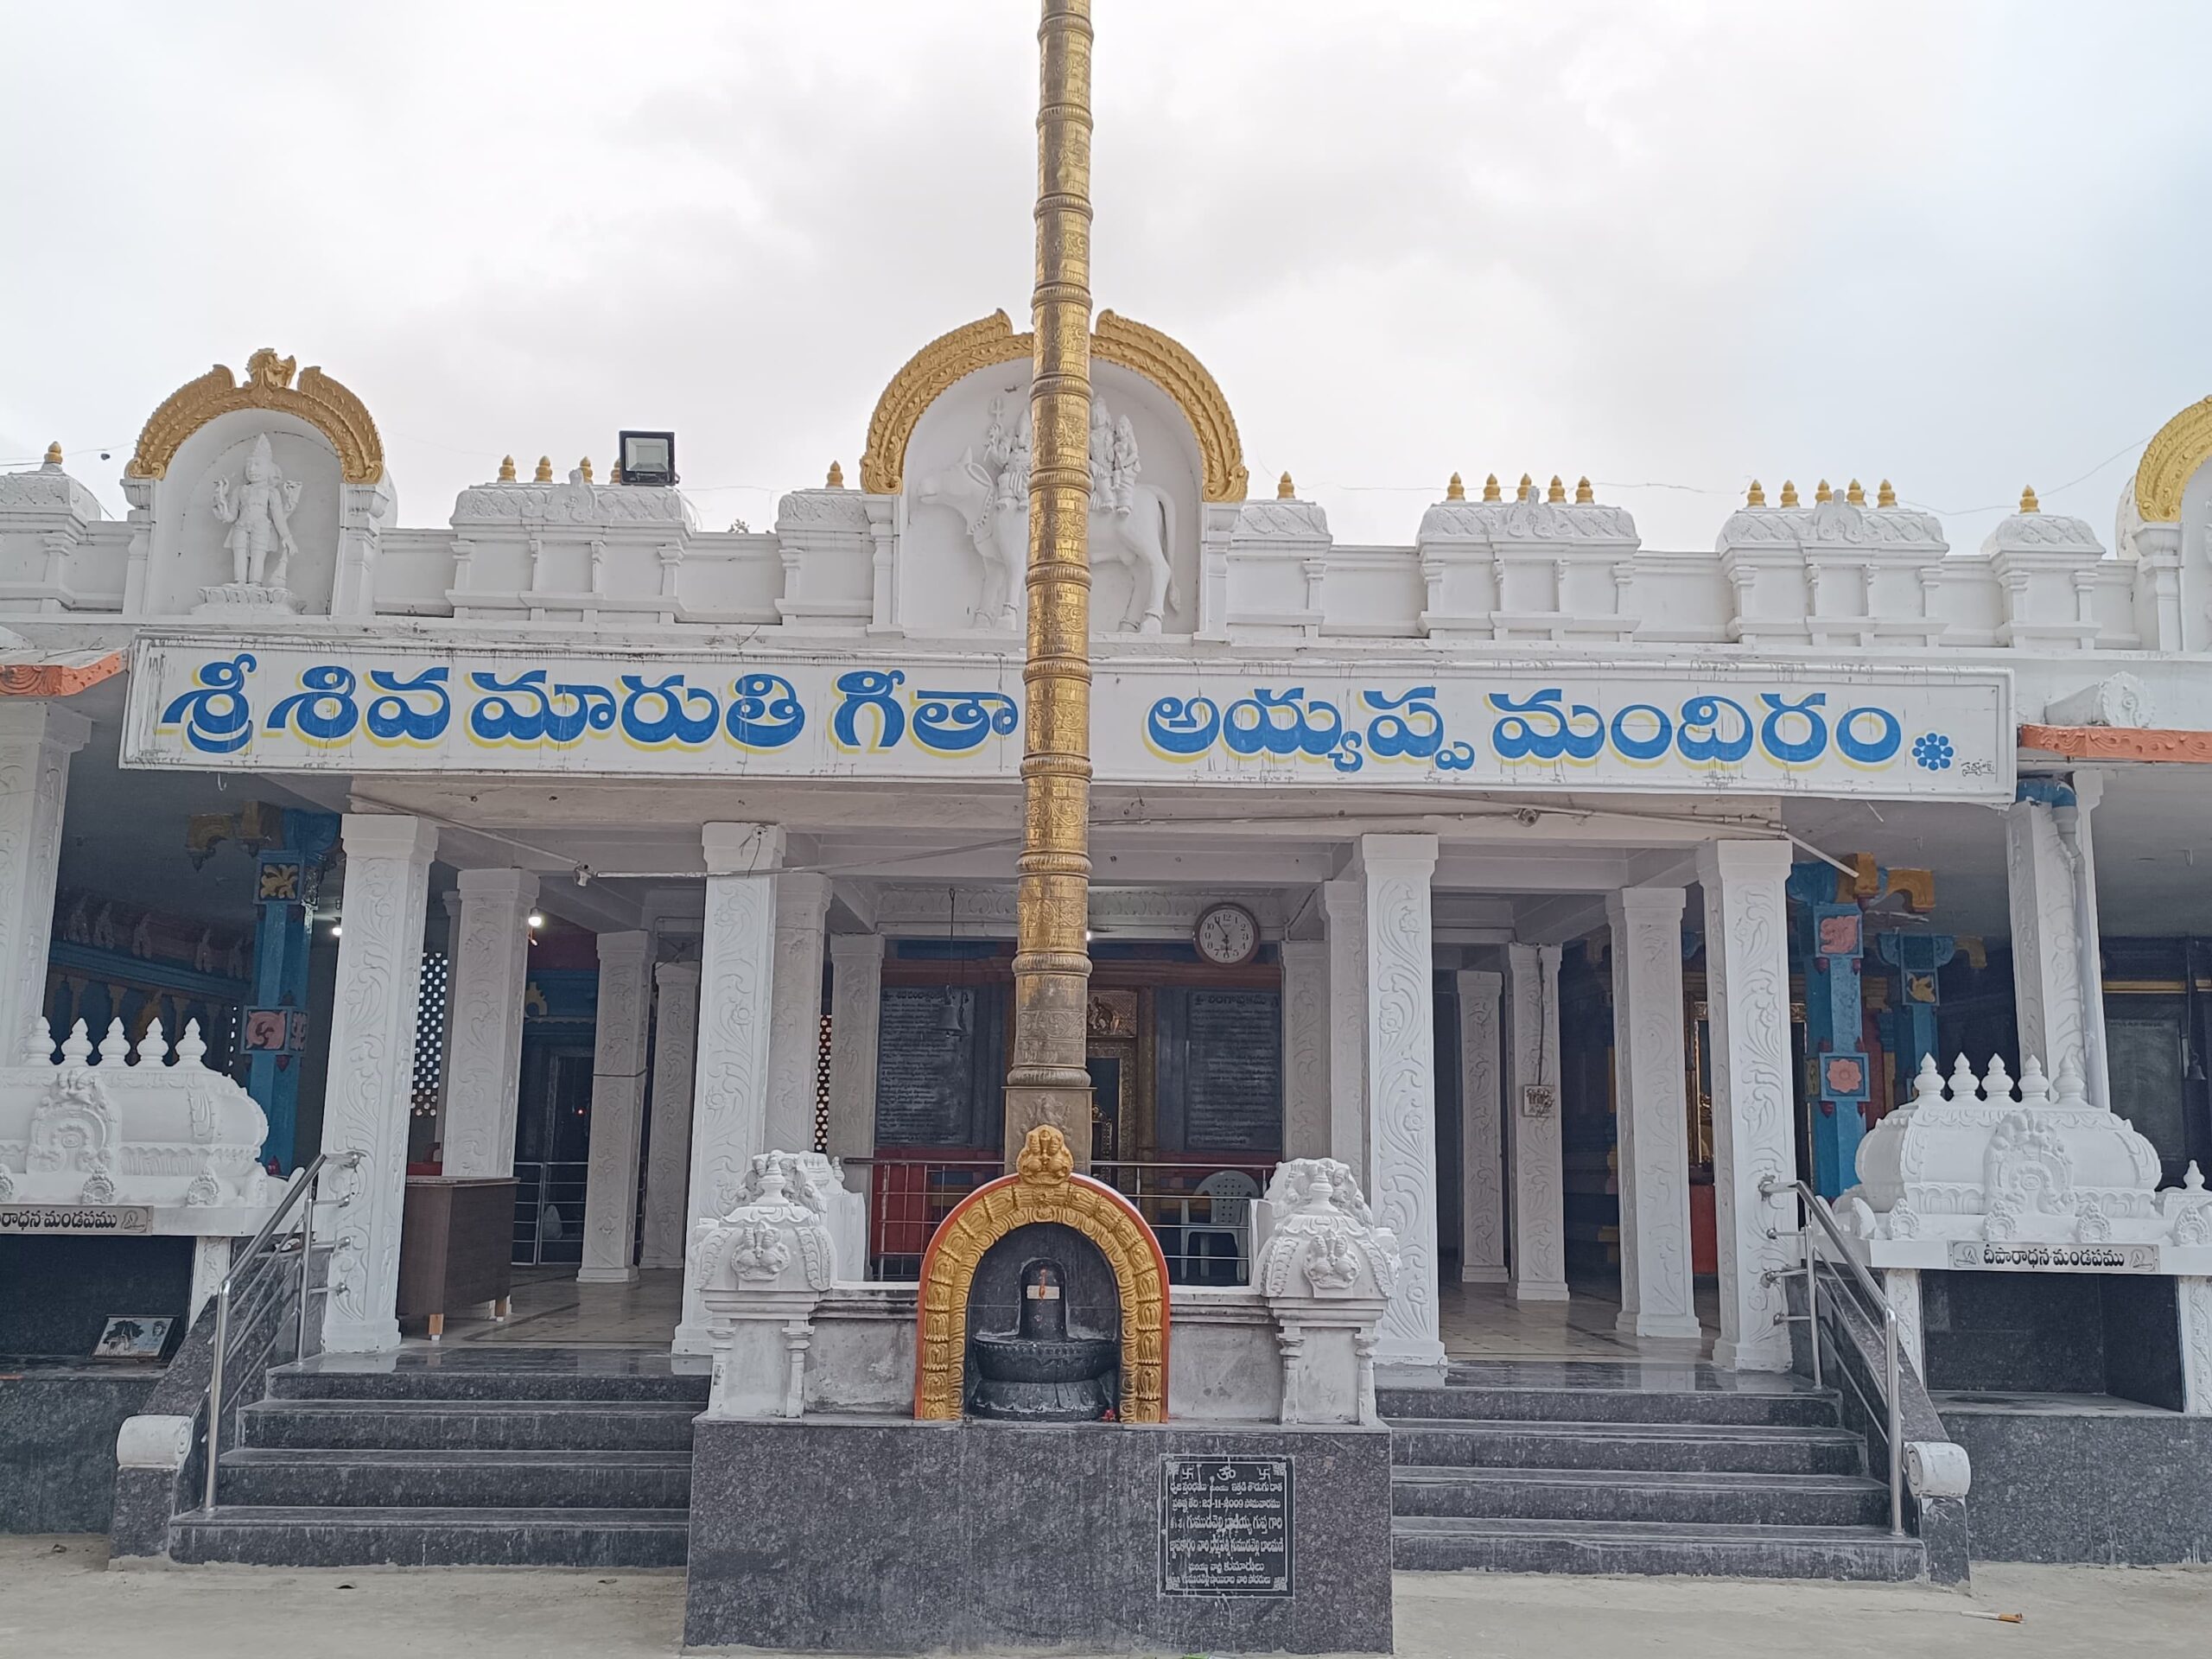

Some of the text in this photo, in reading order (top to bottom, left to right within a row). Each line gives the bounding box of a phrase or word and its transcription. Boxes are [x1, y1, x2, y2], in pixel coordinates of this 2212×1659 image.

[162, 653, 257, 753] శ్రీ
[834, 670, 1019, 750] గీతా
[1148, 686, 1475, 772] అయ్యప్ప
[1488, 688, 1902, 763] మందిరం
[0, 1211, 118, 1230] రాధన మండపము
[2053, 1249, 2125, 1267] మండపము
